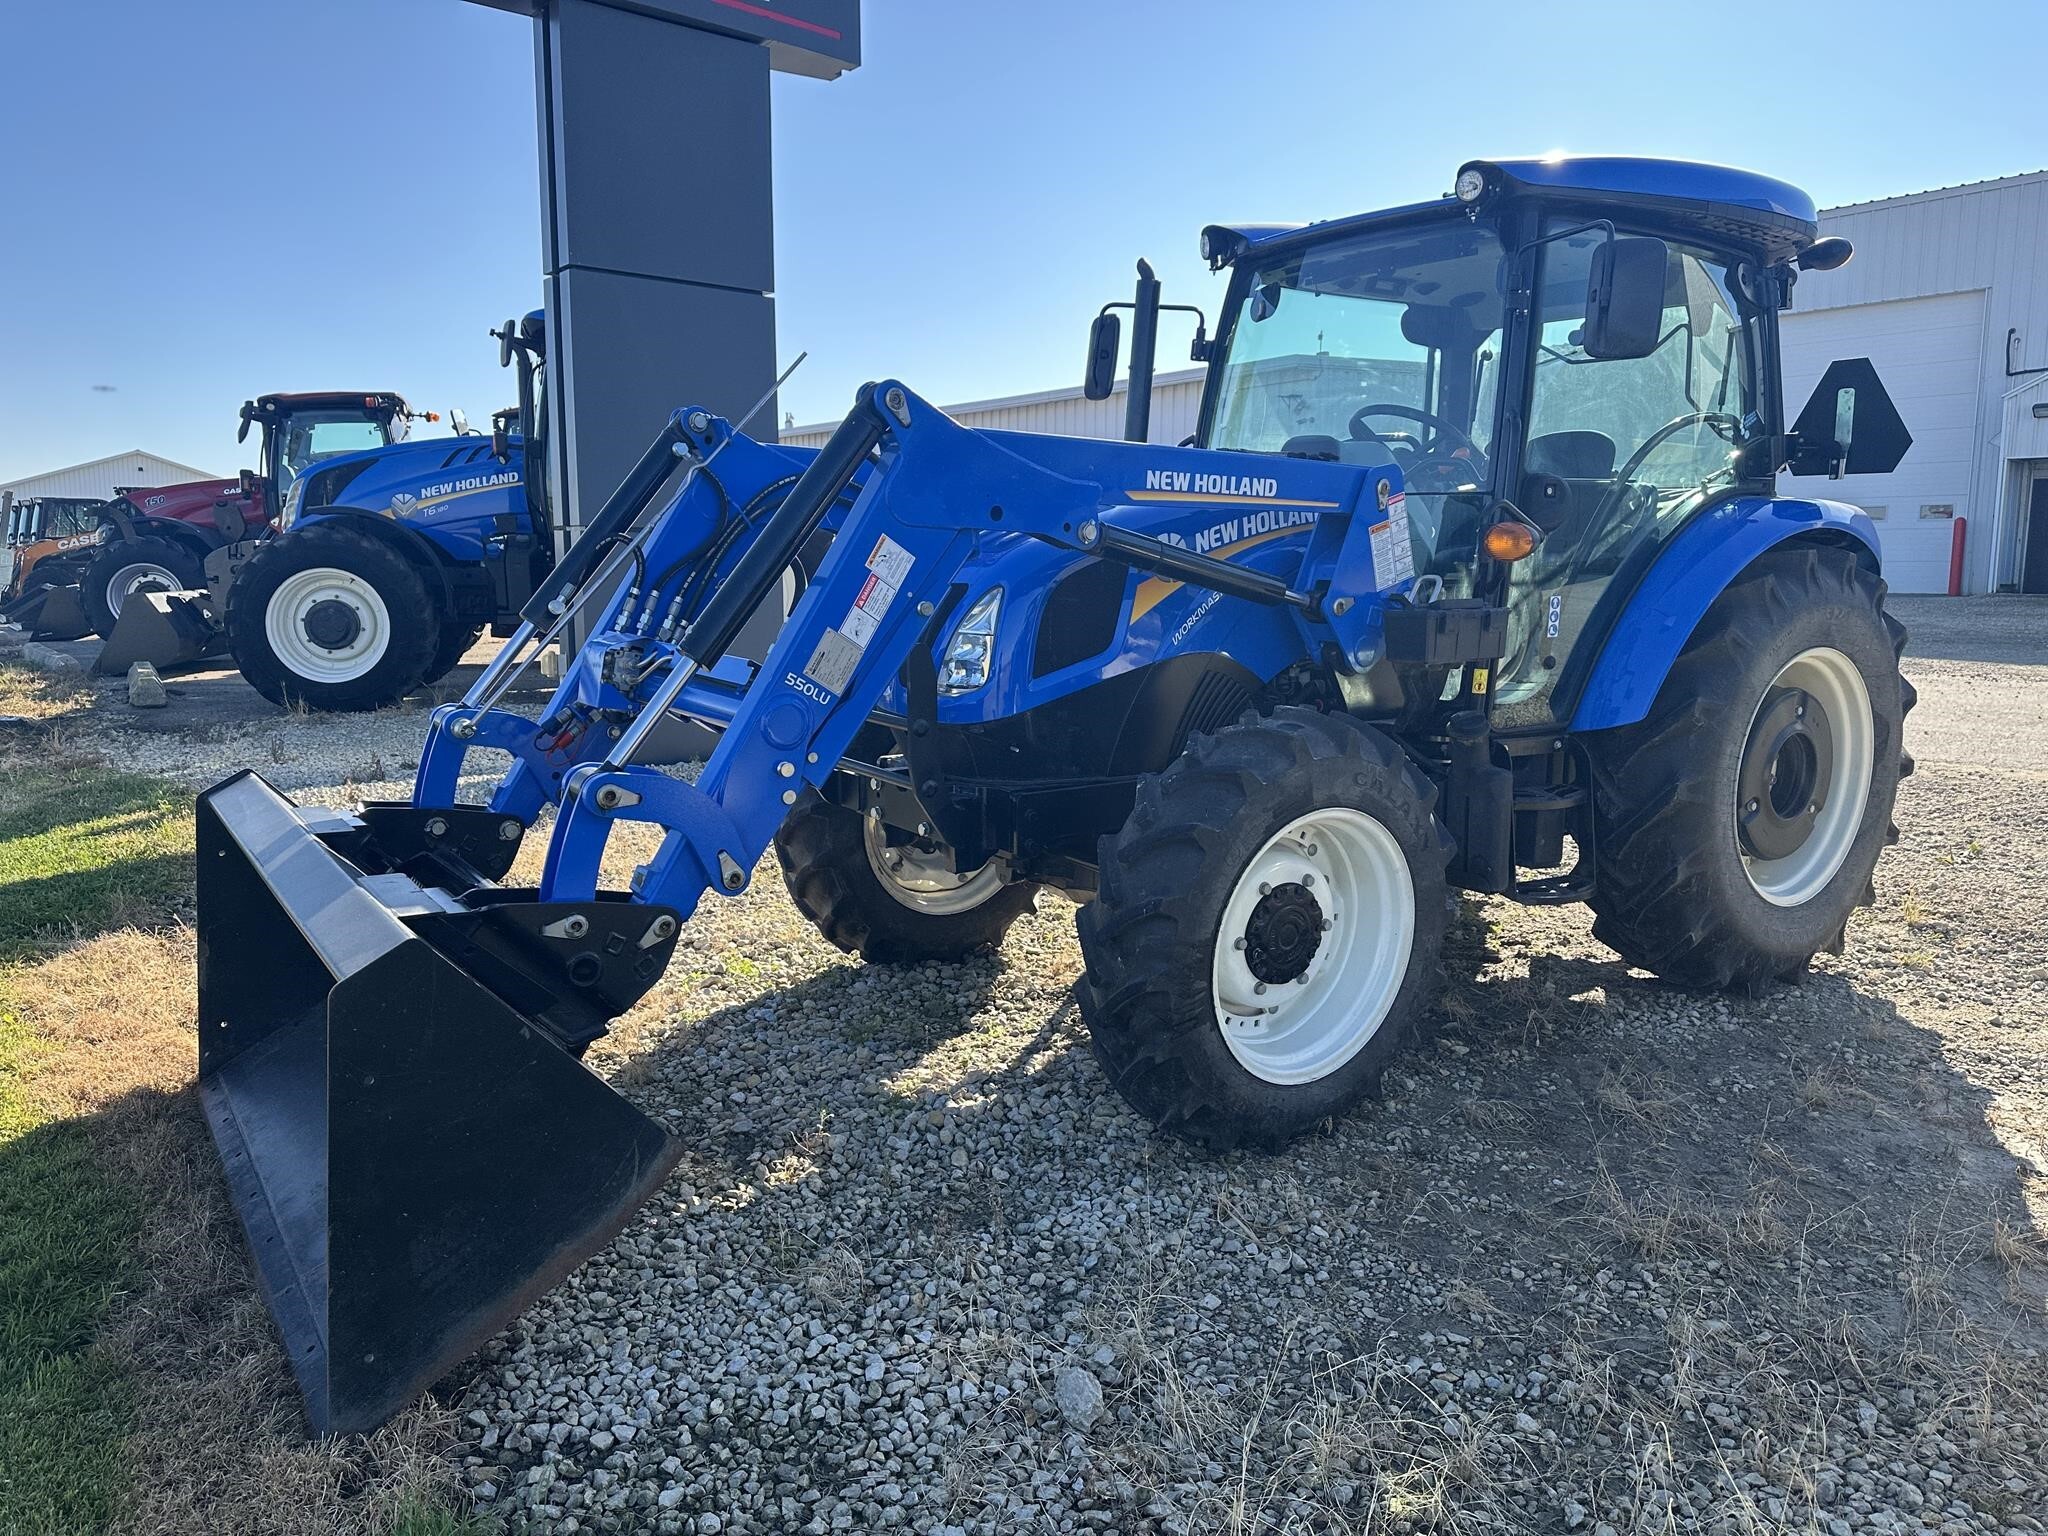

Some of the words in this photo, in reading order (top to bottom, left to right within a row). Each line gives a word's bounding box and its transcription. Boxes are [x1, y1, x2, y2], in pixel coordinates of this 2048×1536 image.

[223, 487, 242, 495] CAS
[420, 482, 453, 499] NEW
[455, 471, 519, 492] HOLLAND
[1146, 470, 1190, 491] NEW
[1194, 473, 1278, 497] HOLLAND
[144, 495, 166, 507] 150
[1195, 519, 1239, 553] NEW
[1243, 510, 1319, 538] HOLLAN
[861, 577, 877, 600] DANGER
[1172, 591, 1223, 646] WORKMAS
[784, 672, 831, 705] 550LU
